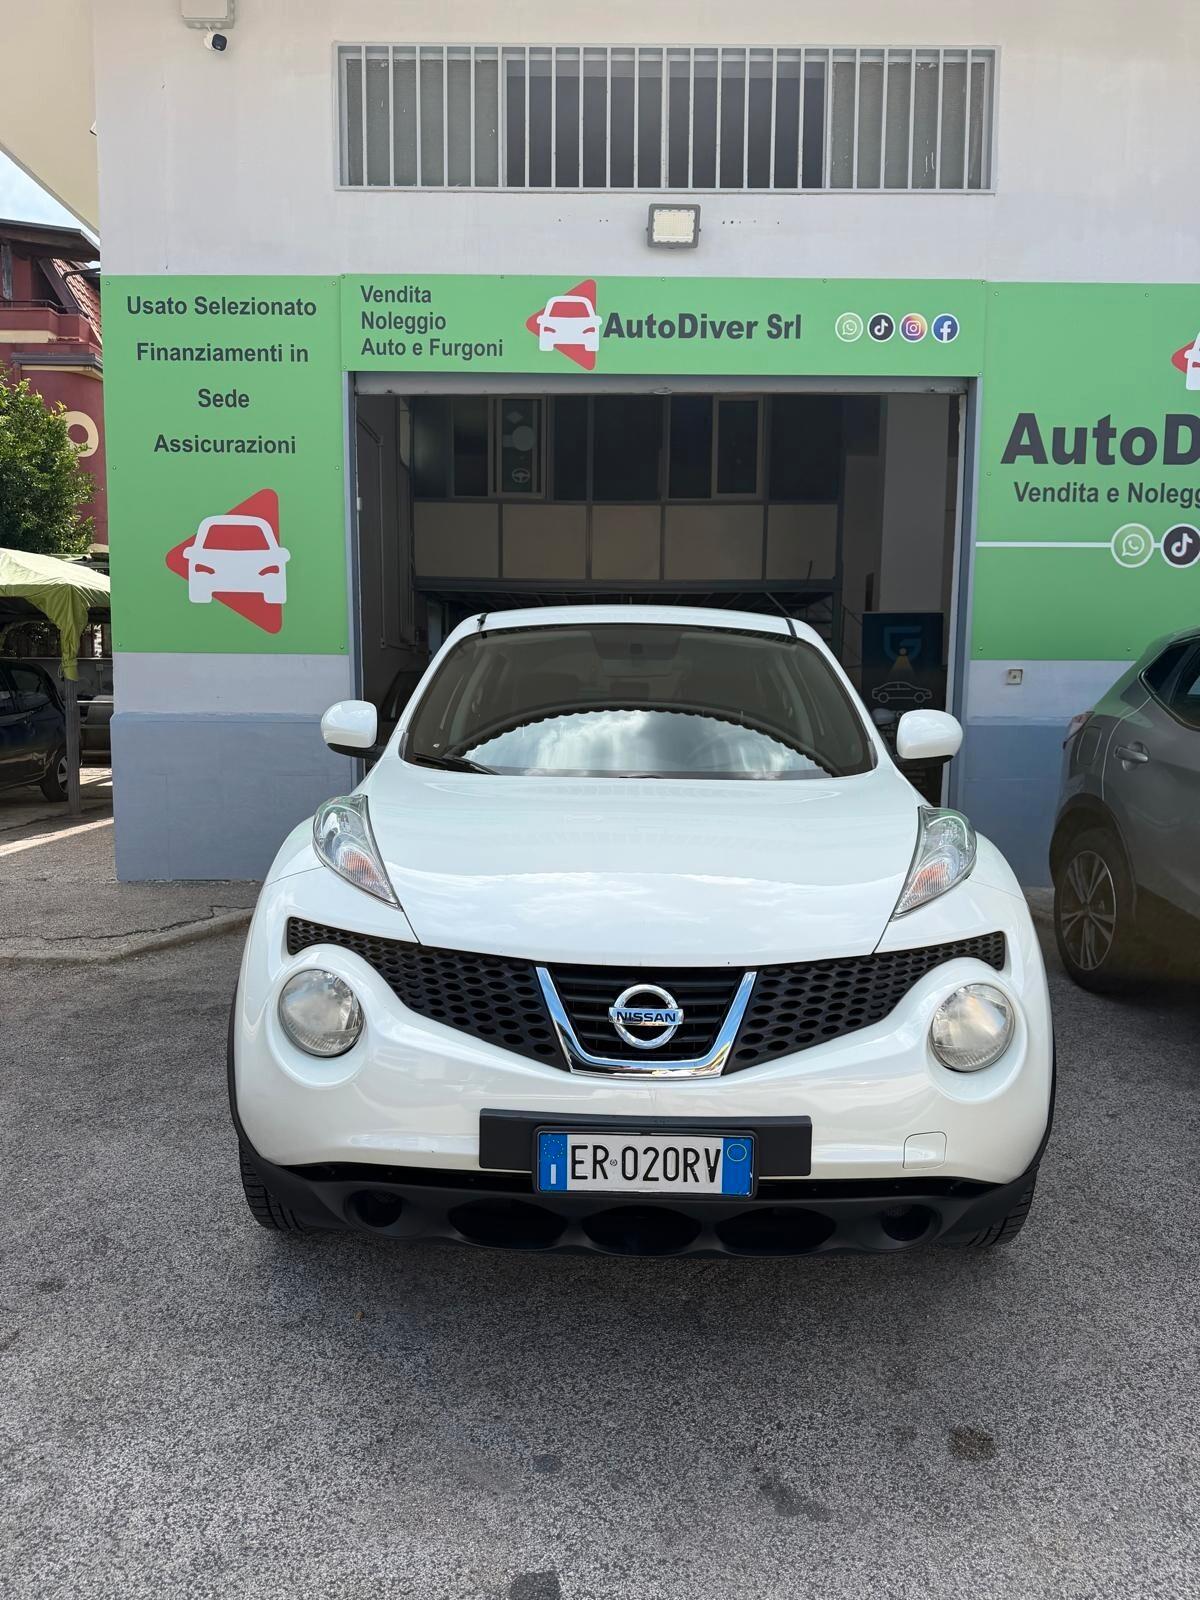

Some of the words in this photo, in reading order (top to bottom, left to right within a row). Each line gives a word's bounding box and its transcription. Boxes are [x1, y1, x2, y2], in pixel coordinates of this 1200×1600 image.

[360, 285, 432, 304] Vendita
[126, 295, 188, 316] Usato
[194, 295, 317, 317] Selezionato
[360, 311, 446, 335] Noleggio
[602, 312, 759, 340] AutoDiver
[765, 313, 803, 340] Srl
[136, 342, 283, 362] Finanziamenti
[290, 343, 309, 363] in
[360, 337, 406, 356] Auto
[412, 342, 423, 356] e
[429, 338, 503, 361] Furgoni
[198, 388, 250, 409] Sede
[153, 433, 296, 455] Assicurazioni
[1000, 412, 1200, 466] AutoD
[1013, 481, 1099, 503] Vendita
[1106, 487, 1120, 503] e
[616, 1011, 676, 1023] NISSAN
